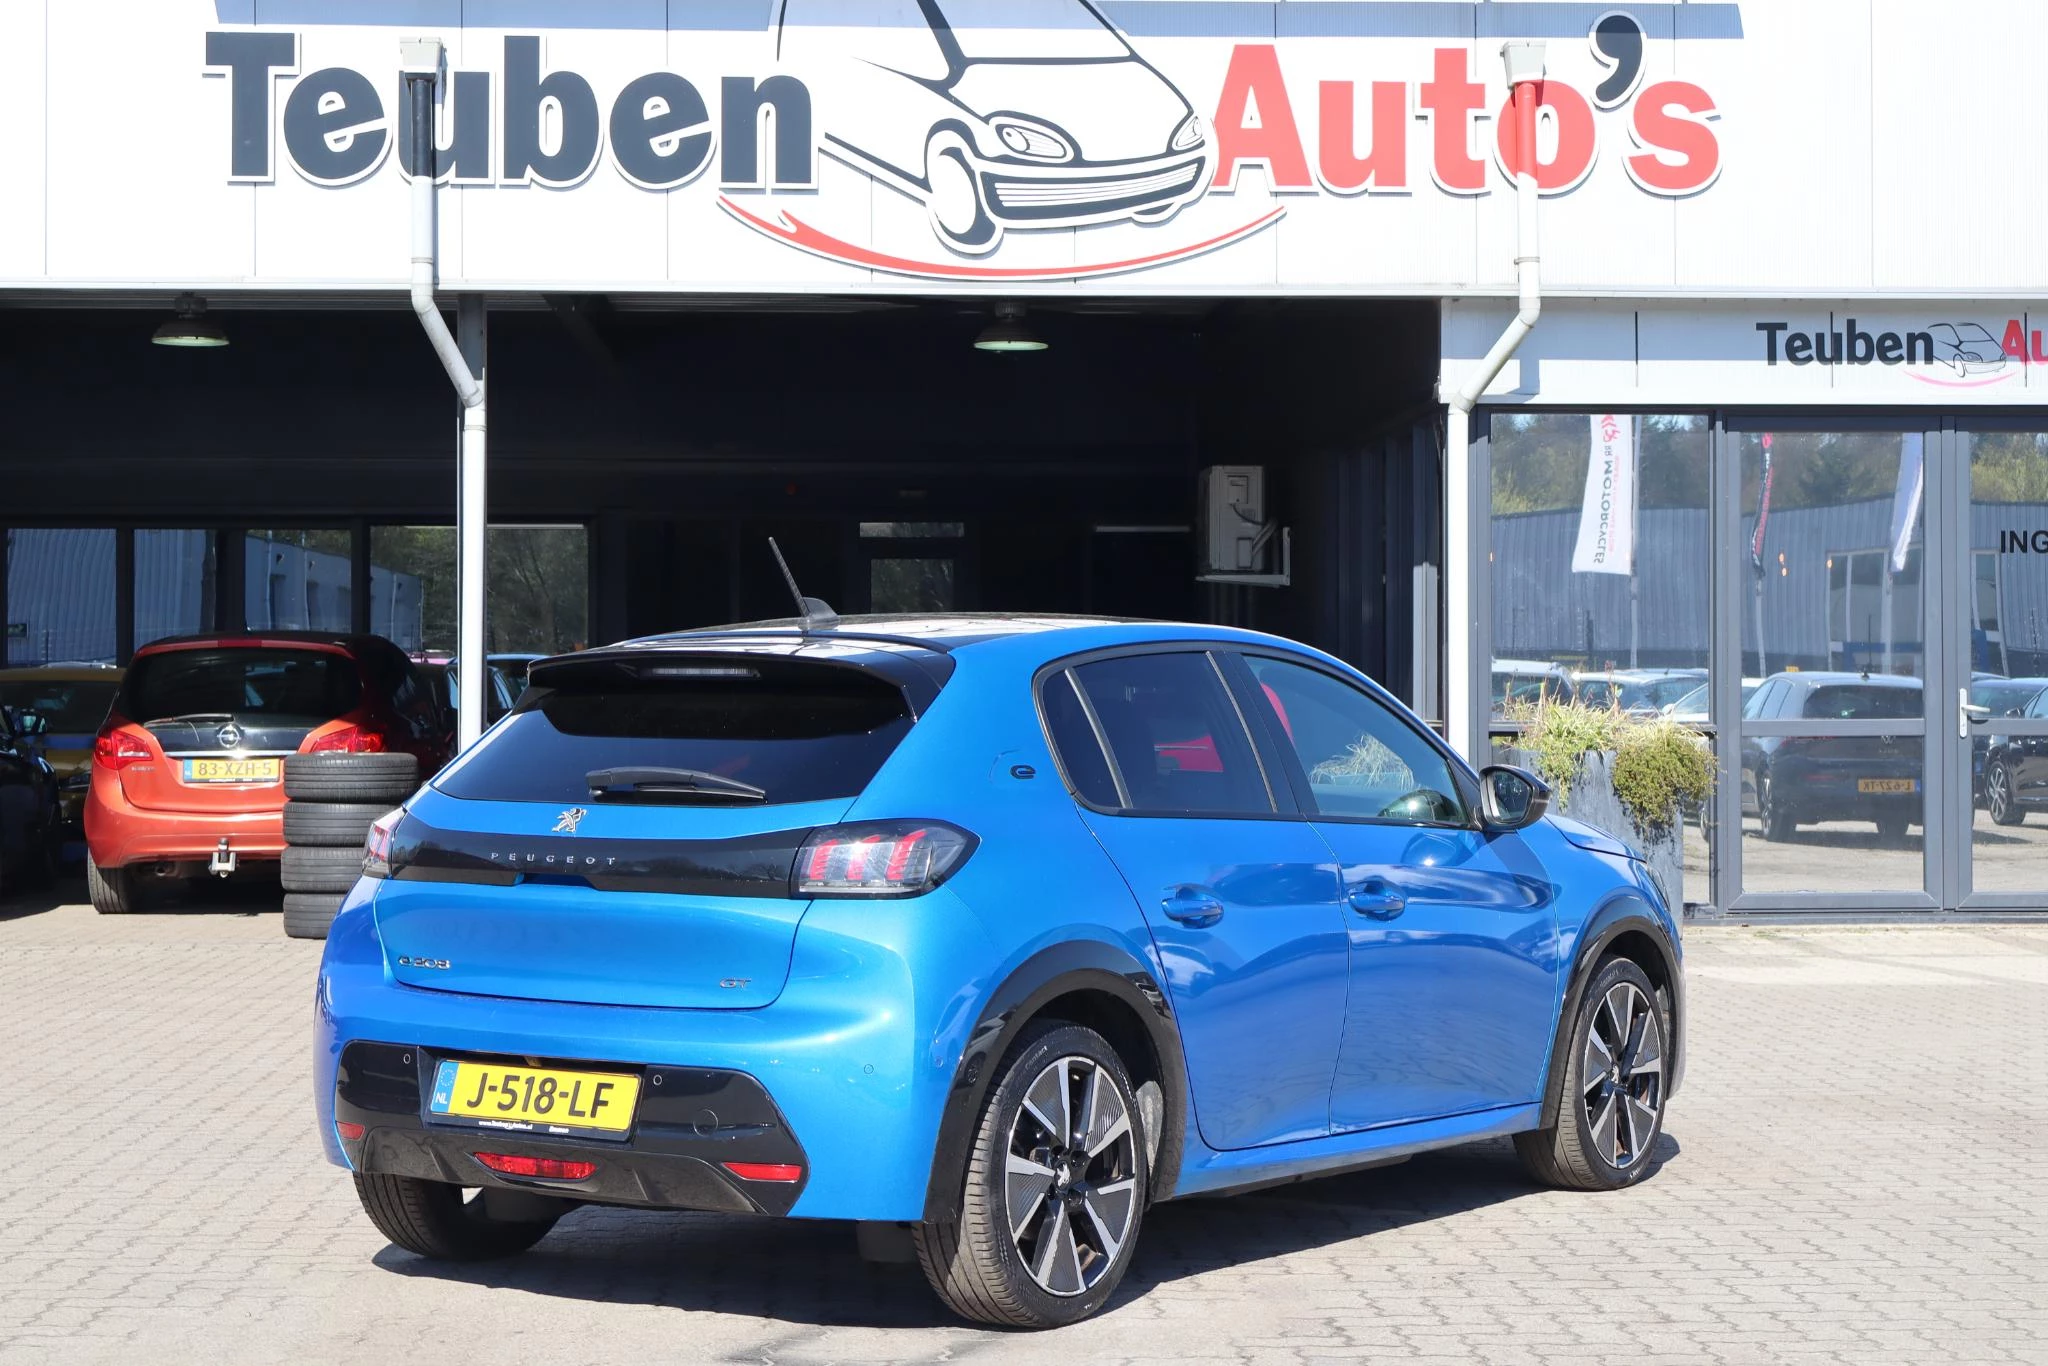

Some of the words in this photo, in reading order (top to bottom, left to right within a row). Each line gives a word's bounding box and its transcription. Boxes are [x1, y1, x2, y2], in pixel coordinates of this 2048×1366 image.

[204, 30, 815, 188] Teuben
[1209, 12, 1721, 192] Auto's
[1755, 318, 1934, 366] Teuben
[2000, 530, 2048, 554] ING
[198, 761, 272, 776] 83-XZH-5
[490, 852, 616, 865] PEUGEOT
[719, 977, 752, 989] GT
[434, 1092, 448, 1105] NL
[466, 1072, 615, 1119] J-518-LF
